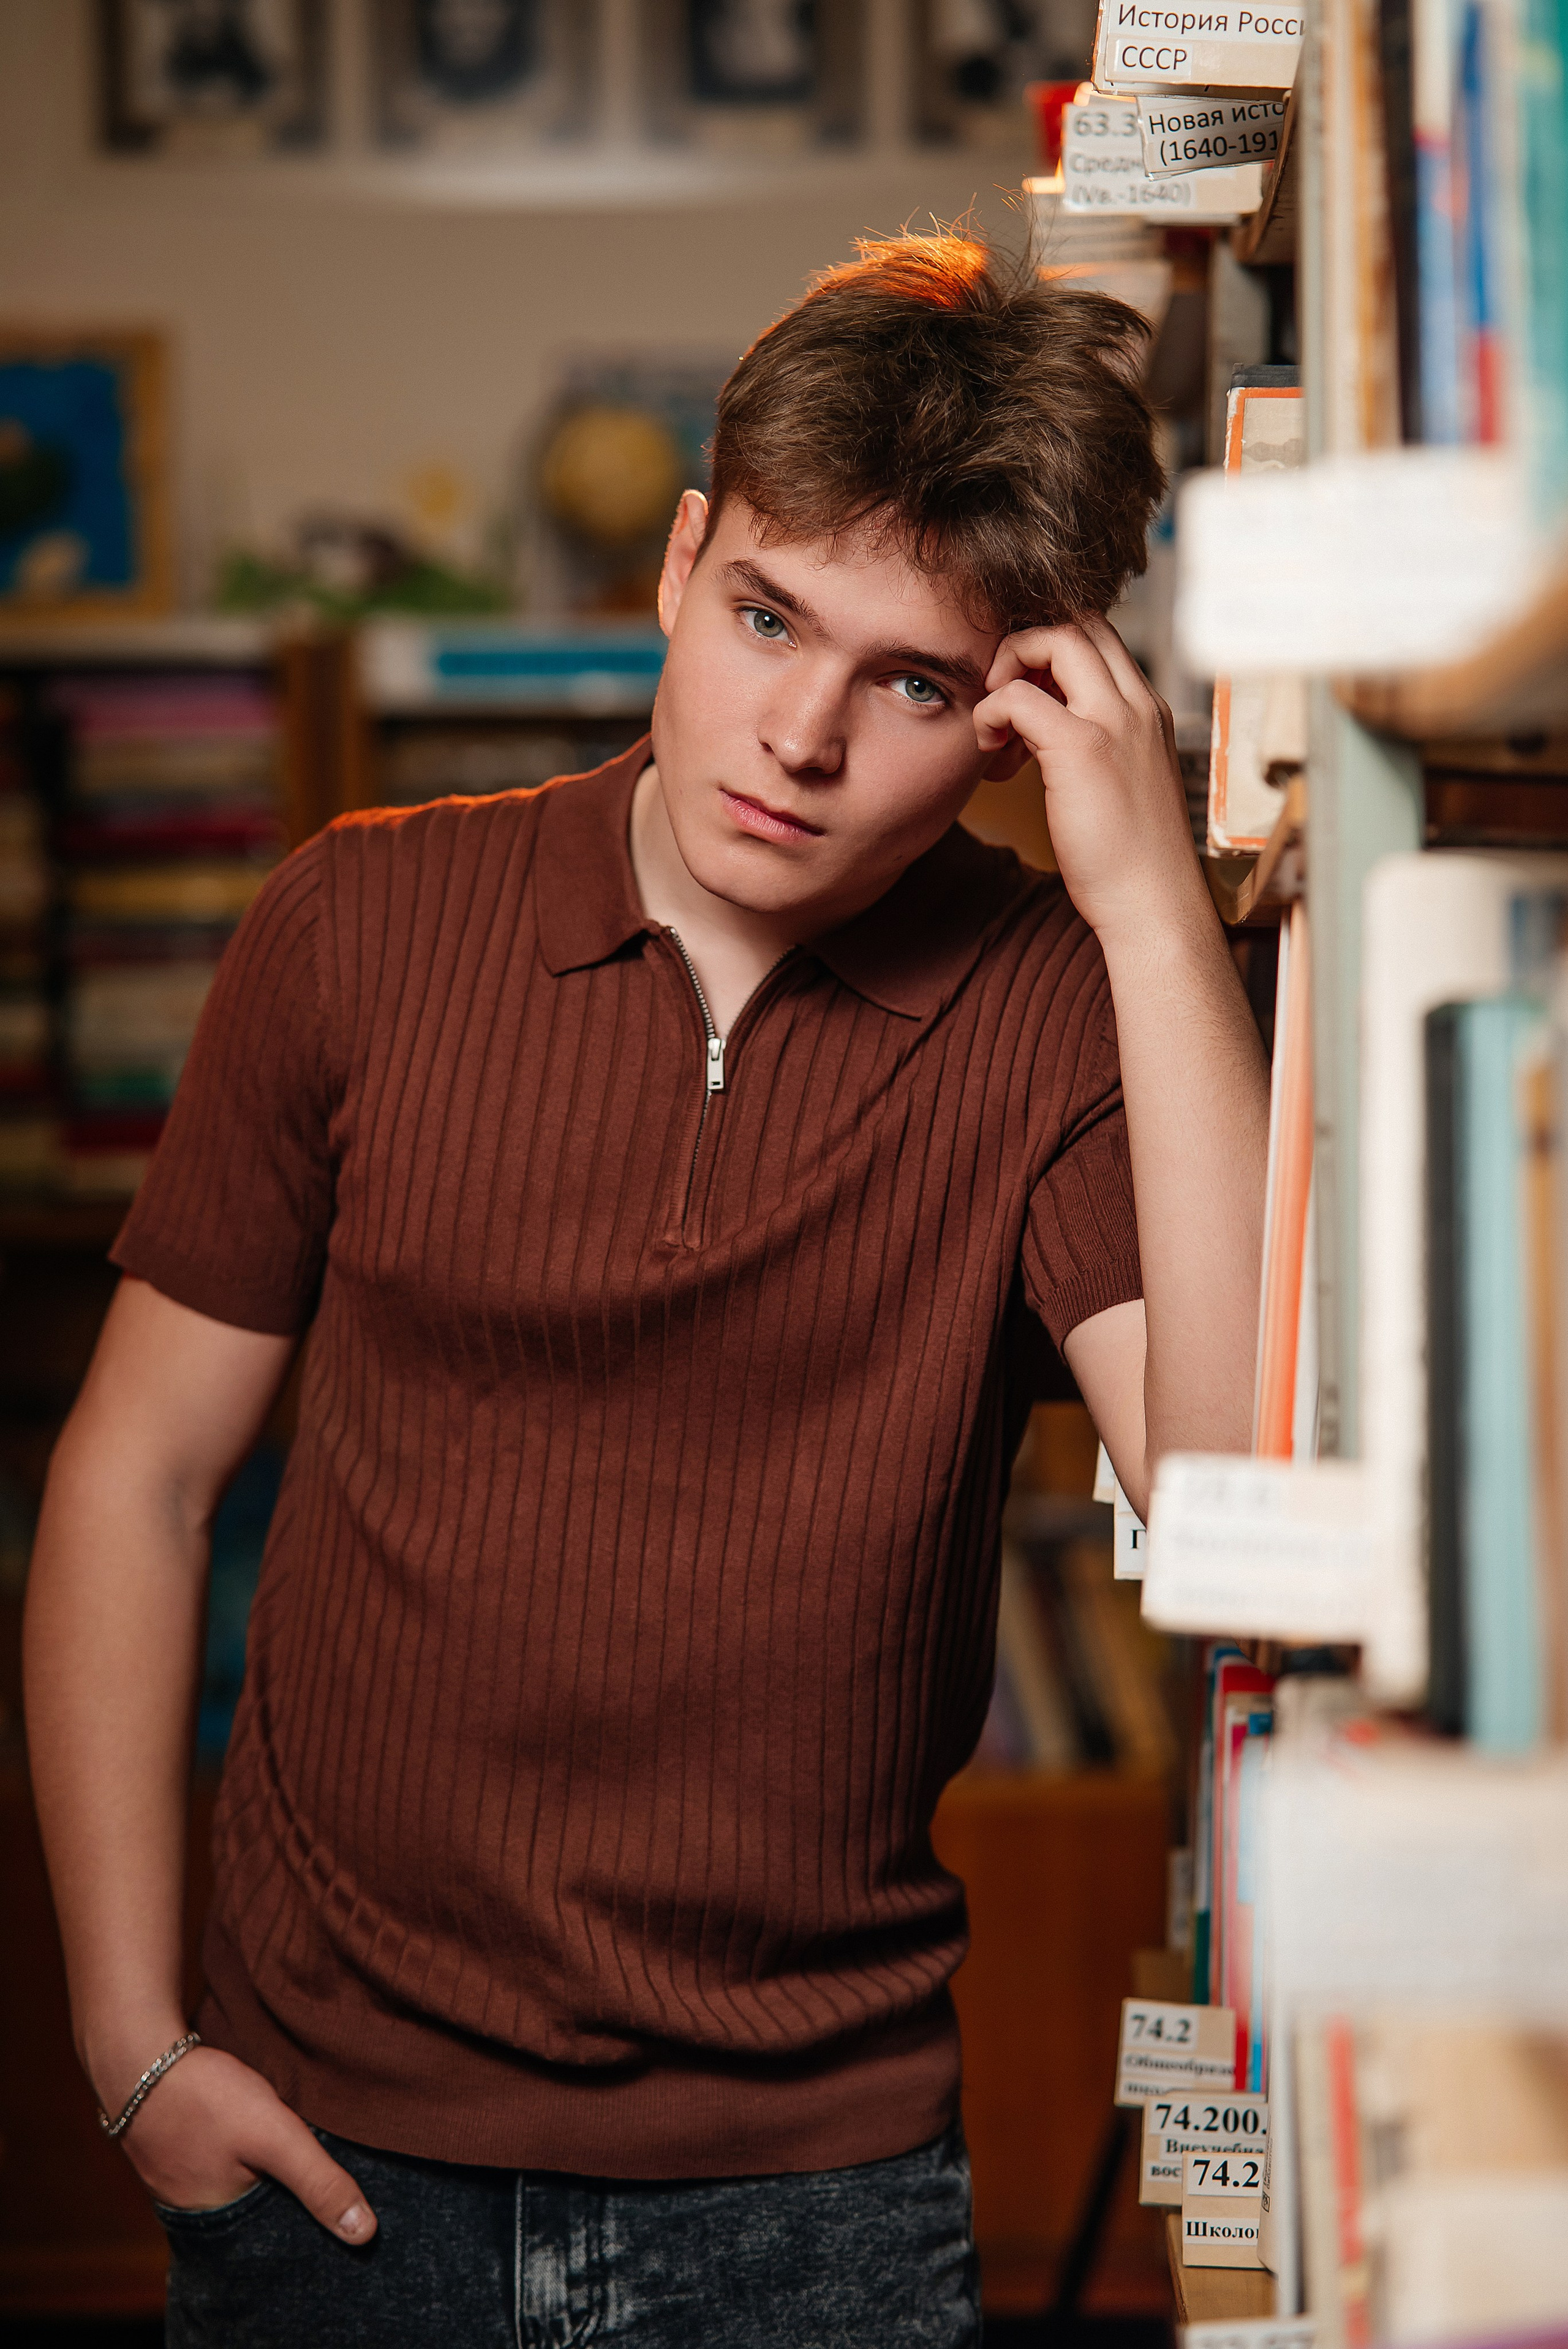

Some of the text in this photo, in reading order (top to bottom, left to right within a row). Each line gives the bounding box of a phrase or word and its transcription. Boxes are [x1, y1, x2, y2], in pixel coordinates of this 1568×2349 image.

[1118, 4, 1303, 36] История Росс
[1122, 45, 1188, 70] СССР
[1149, 104, 1284, 134] Новая исто
[1131, 2013, 1191, 2043] 74.2
[1156, 2103, 1267, 2134] 74.200.
[1193, 2159, 1260, 2188] 74.2
